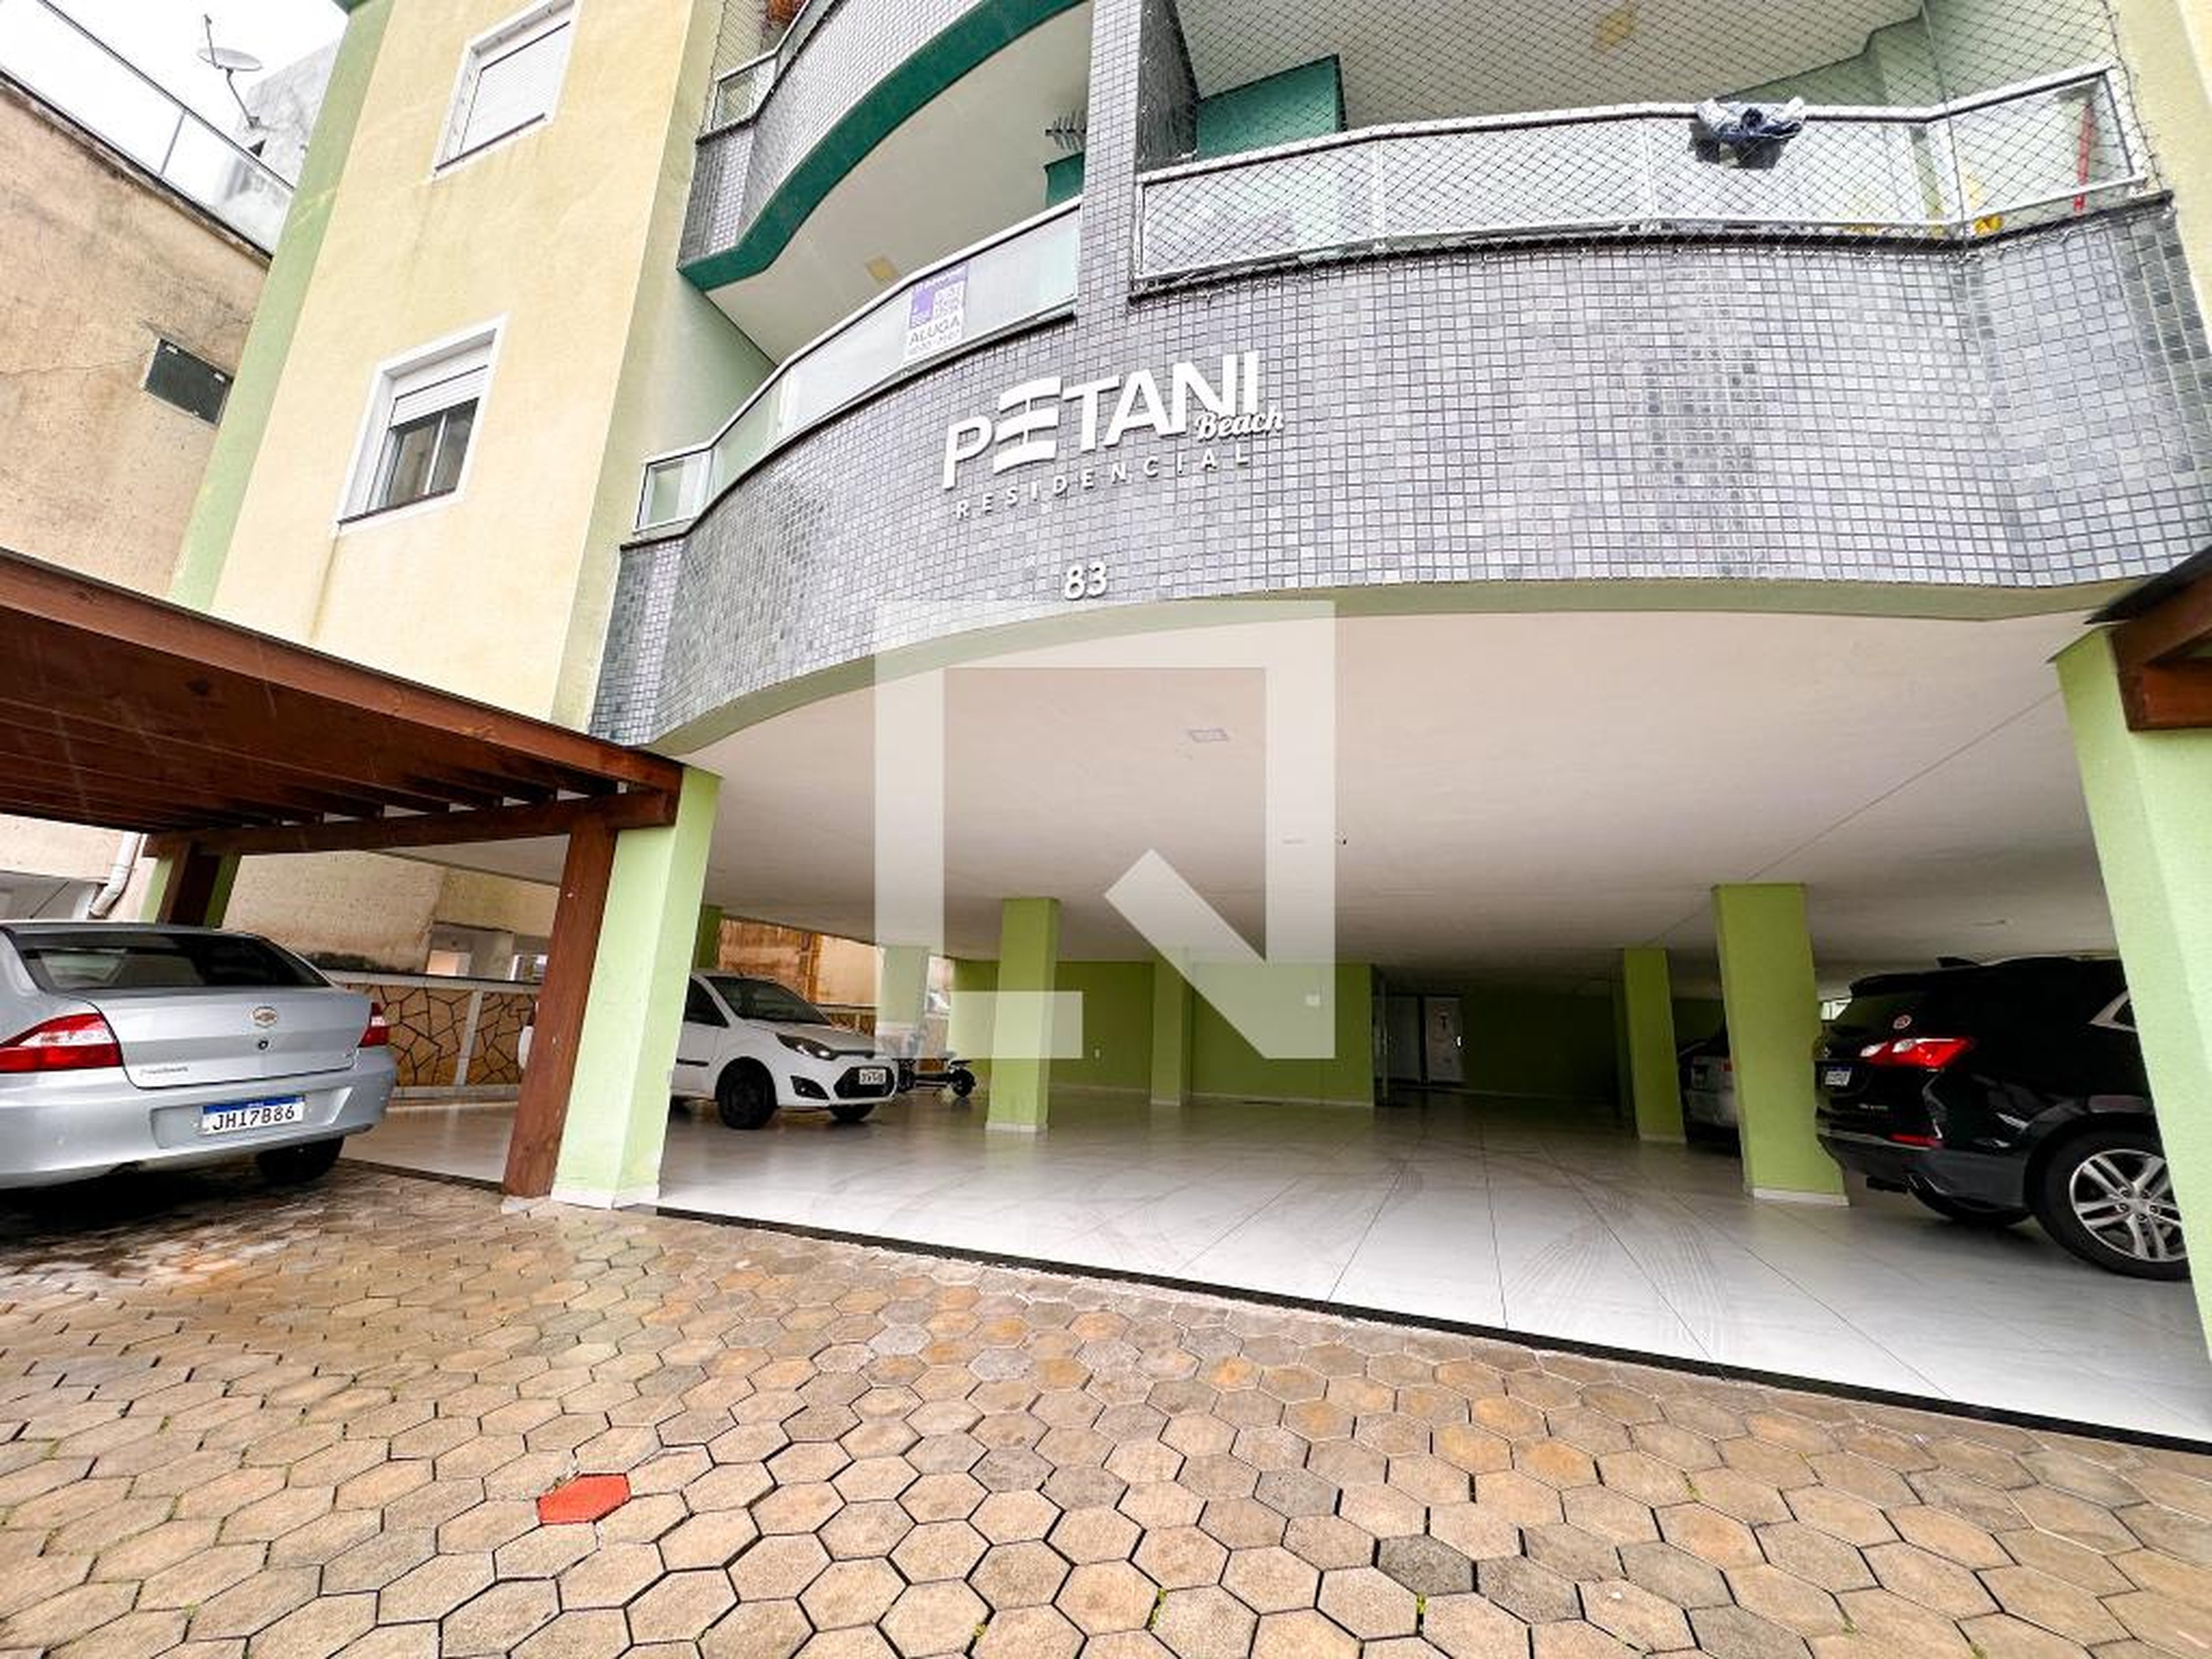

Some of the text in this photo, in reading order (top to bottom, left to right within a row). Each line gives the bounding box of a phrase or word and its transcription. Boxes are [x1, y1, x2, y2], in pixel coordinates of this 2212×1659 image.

[909, 315, 960, 346] ALUGA
[942, 351, 1260, 491] PETANI
[1196, 408, 1285, 442] Beach
[955, 445, 1250, 520] RESIDENCIAL
[1065, 561, 1107, 601] 83
